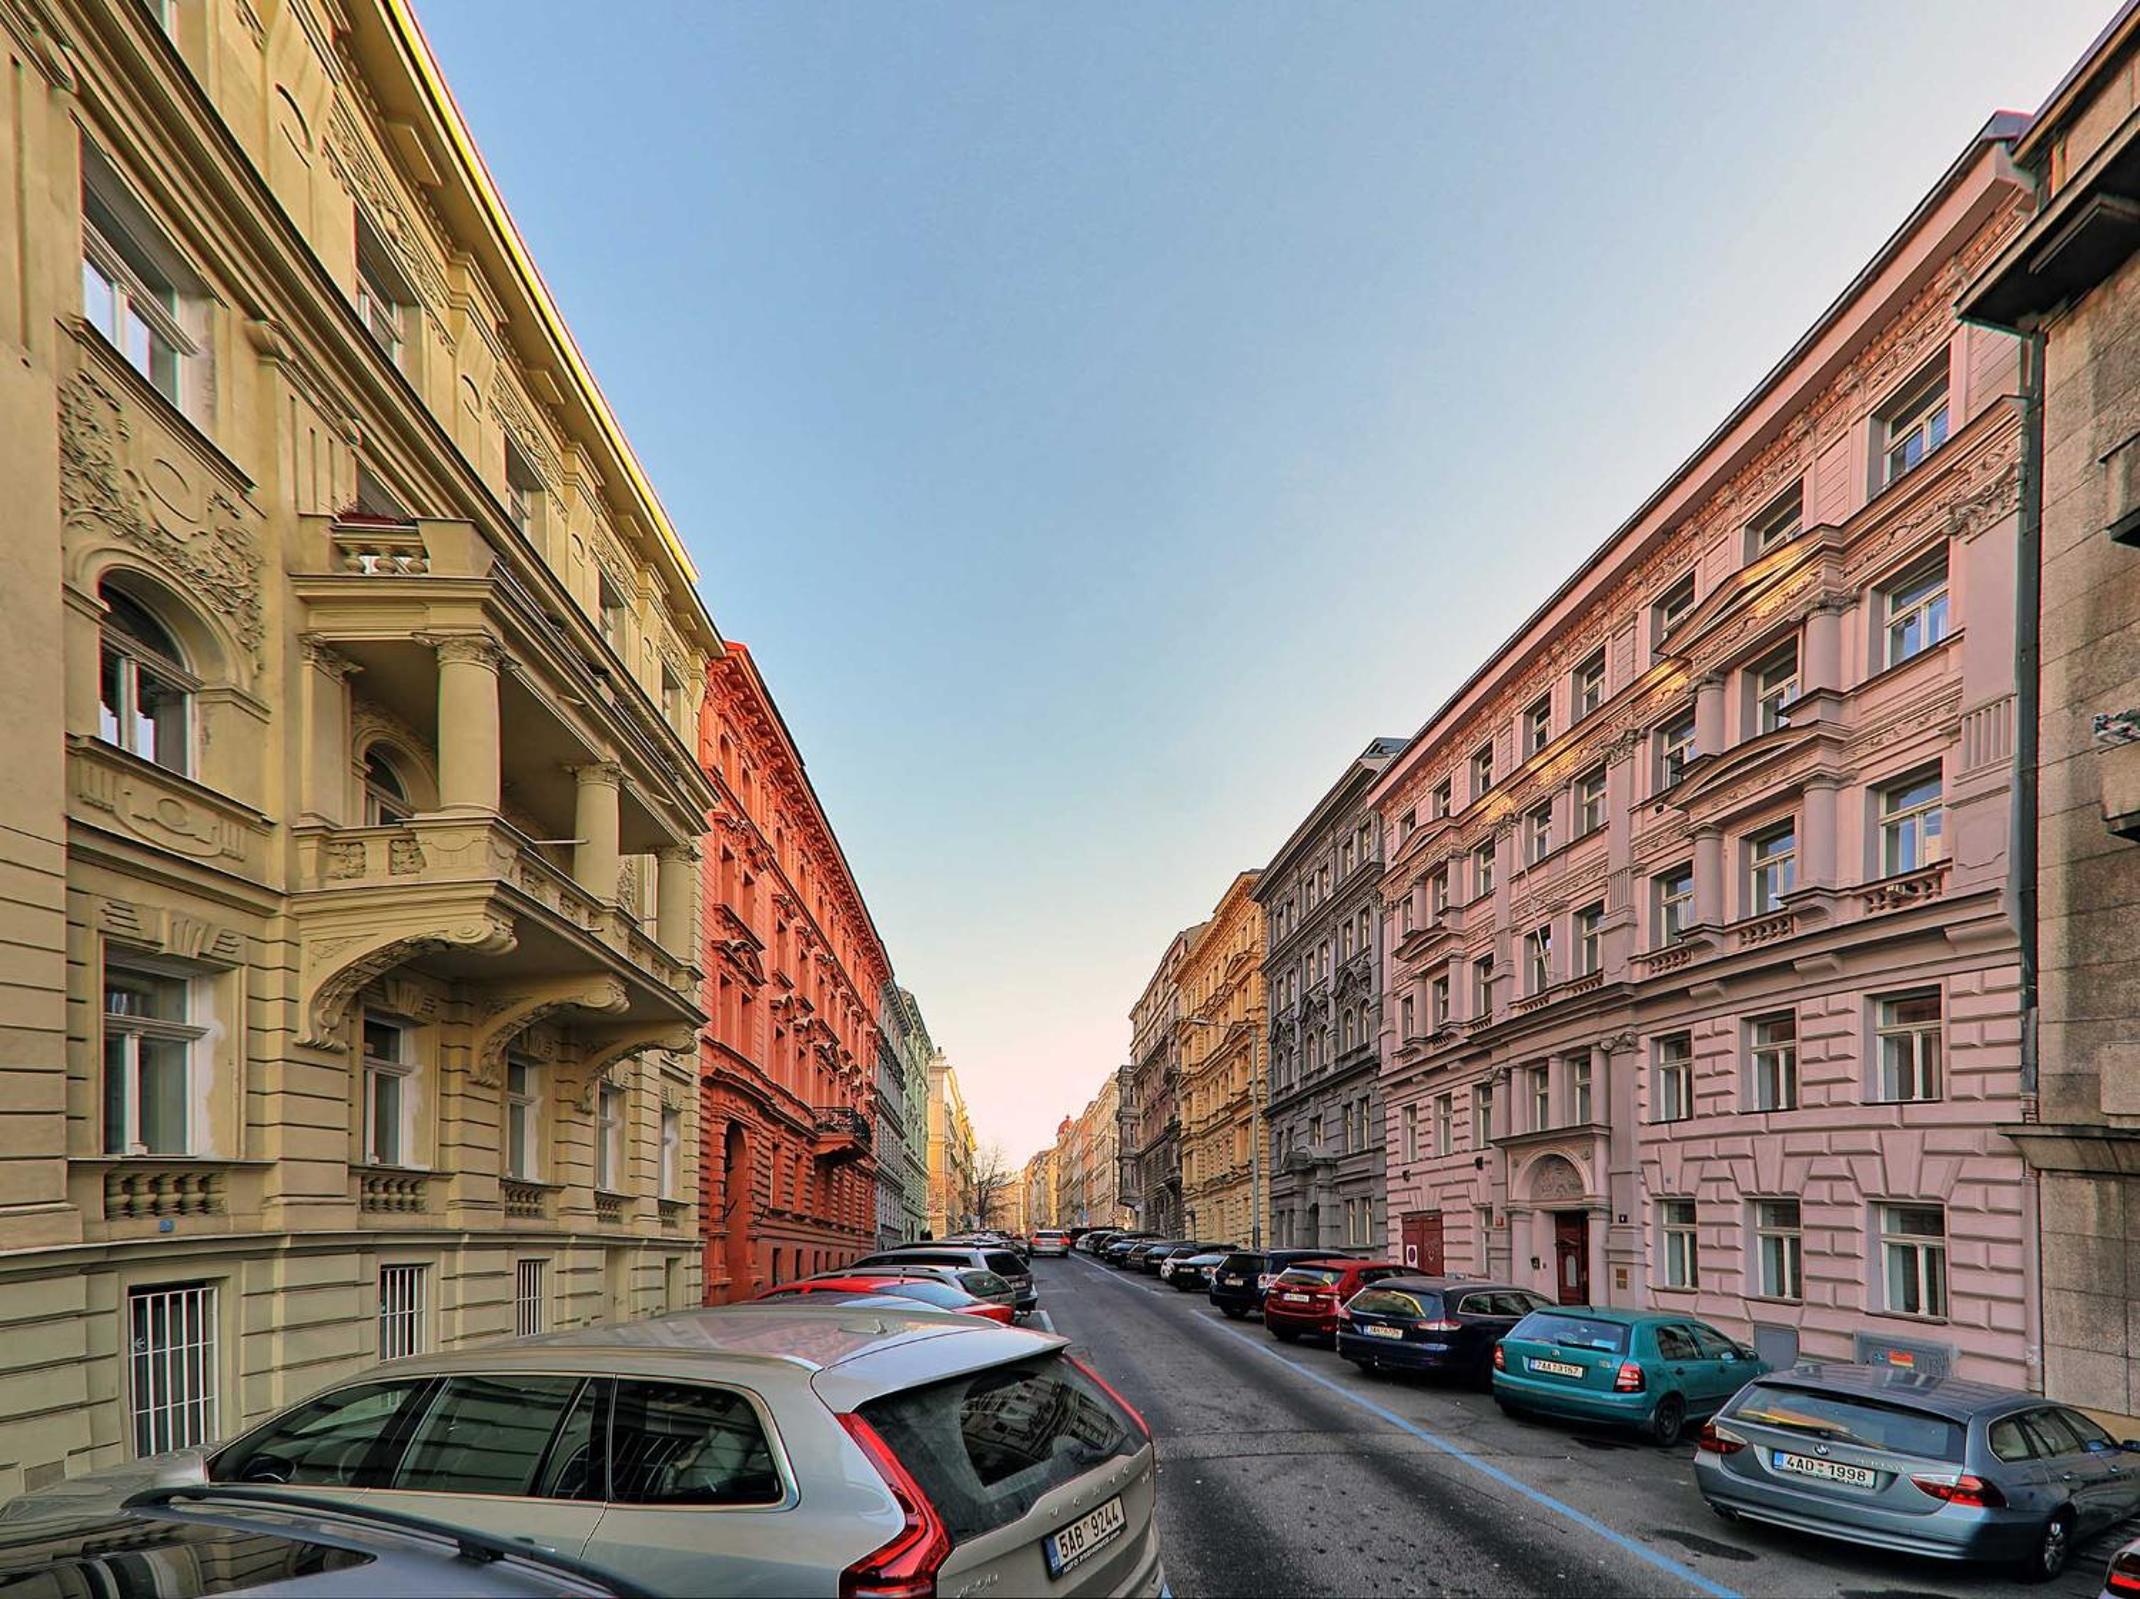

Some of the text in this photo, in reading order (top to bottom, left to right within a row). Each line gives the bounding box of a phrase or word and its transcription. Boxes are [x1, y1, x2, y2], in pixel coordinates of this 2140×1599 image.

[1787, 1456, 1814, 1471] 4AD
[1828, 1465, 1866, 1482] 1998
[1059, 1525, 1084, 1559] 5AB
[1091, 1502, 1119, 1538] 9244
